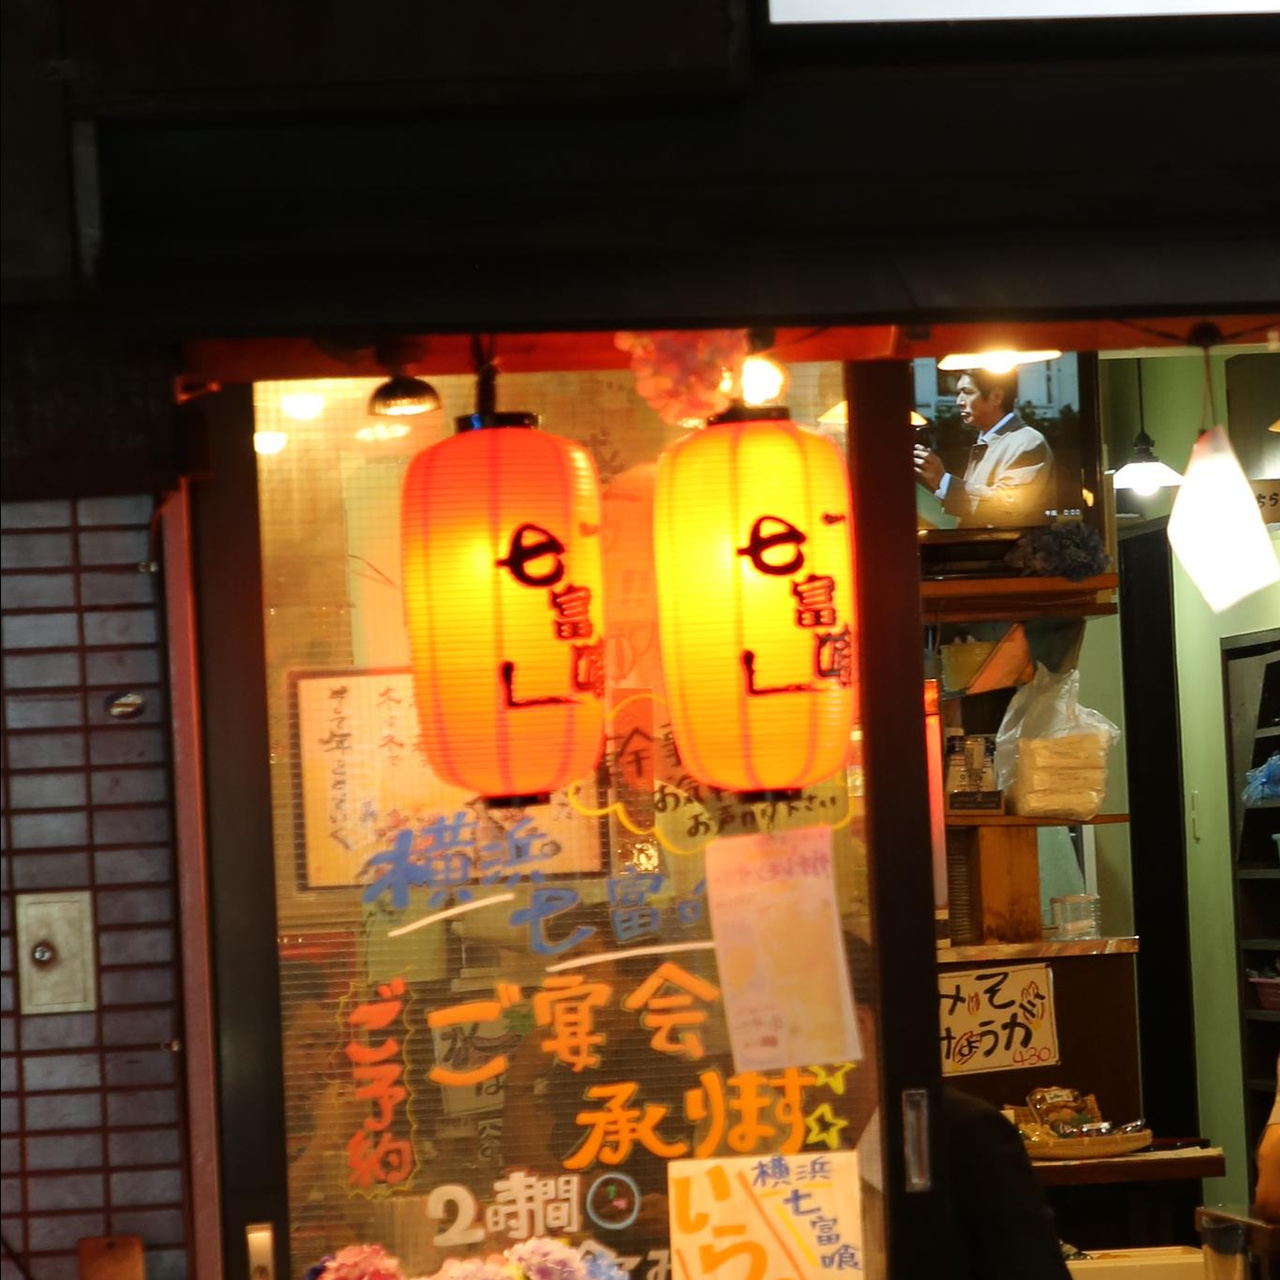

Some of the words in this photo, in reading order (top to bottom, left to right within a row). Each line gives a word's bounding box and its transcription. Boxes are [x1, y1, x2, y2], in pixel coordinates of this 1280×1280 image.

[426, 961, 720, 1086] ご宴会
[344, 976, 413, 1189] ご予約
[562, 1066, 818, 1171] 承ります
[425, 1170, 584, 1248] 2時間
[751, 1156, 834, 1188] 横浜
[782, 1187, 864, 1273] 七富喰
